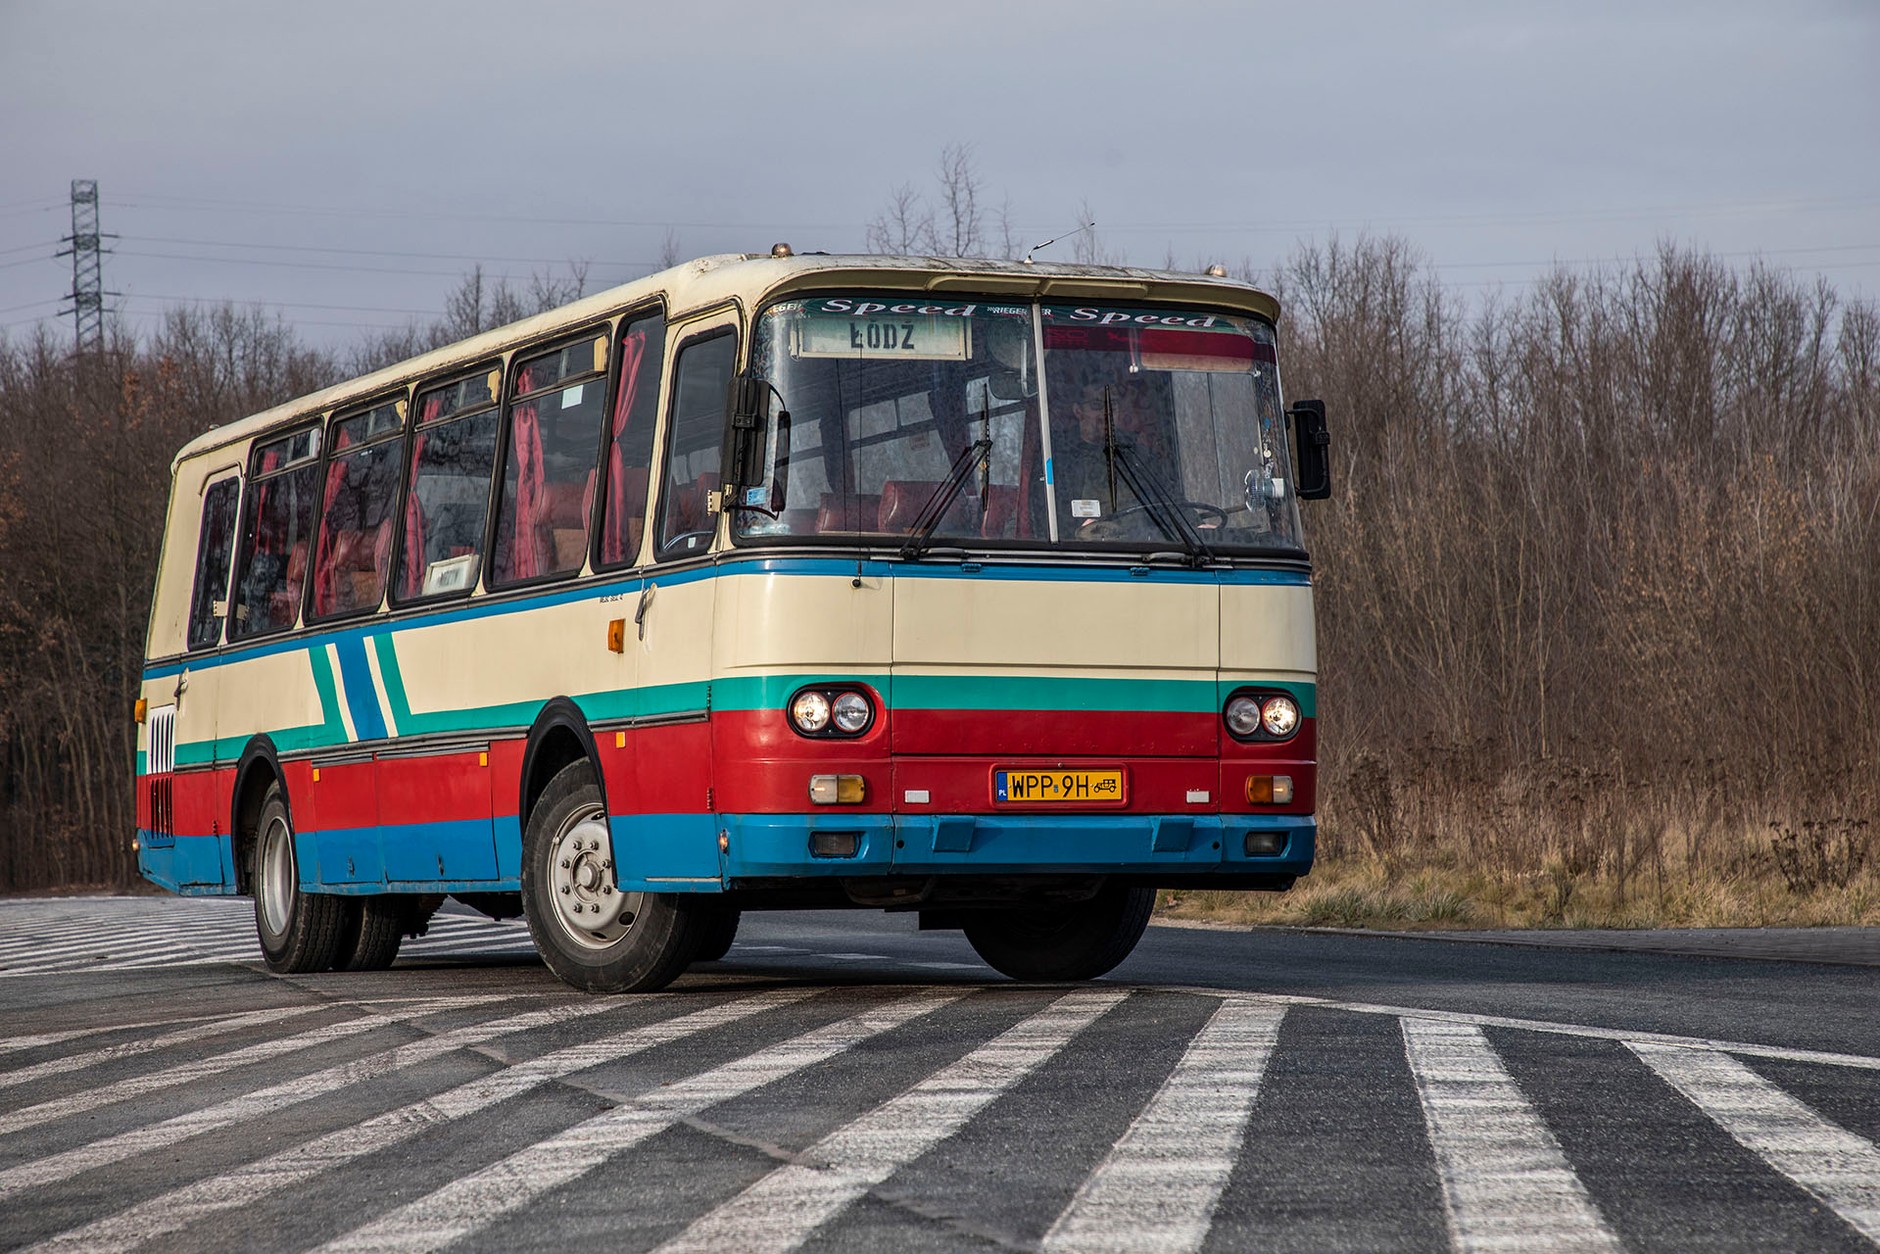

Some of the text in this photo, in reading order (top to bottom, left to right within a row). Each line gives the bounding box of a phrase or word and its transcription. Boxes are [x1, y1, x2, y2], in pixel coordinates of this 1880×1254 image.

[821, 299, 978, 317] Speed
[1069, 307, 1217, 328] Speed
[998, 789, 1007, 797] PL
[1011, 775, 1089, 798] WPP 9H
